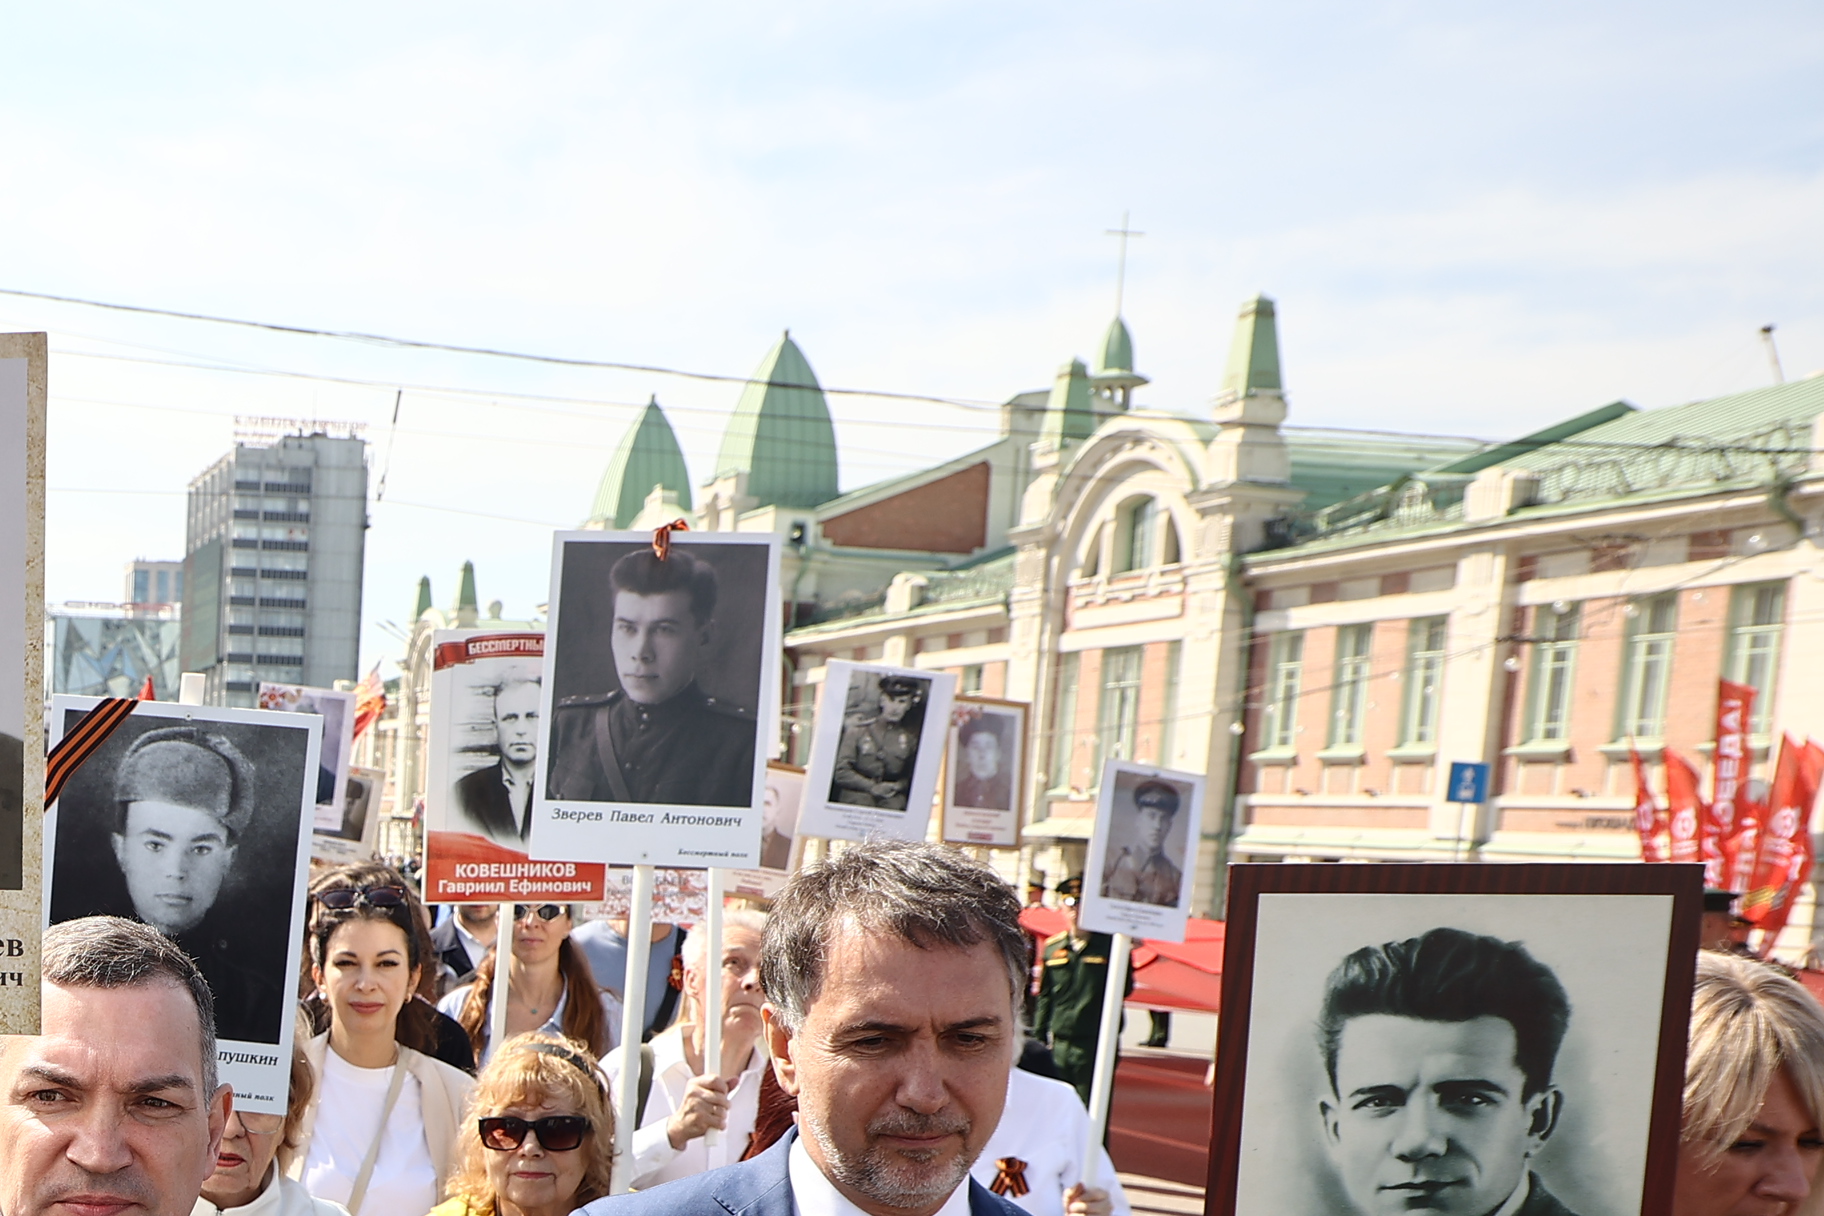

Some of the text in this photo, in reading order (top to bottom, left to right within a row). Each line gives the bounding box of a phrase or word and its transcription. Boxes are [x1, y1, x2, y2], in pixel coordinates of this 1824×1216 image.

[468, 639, 544, 655] БЕССМЕРТНЫ
[551, 808, 742, 827] Зверев Павел Антонович
[455, 863, 576, 878] КОВЕШНИКОВ
[438, 880, 505, 896] Гавриил
[509, 879, 592, 895] Ефимович
